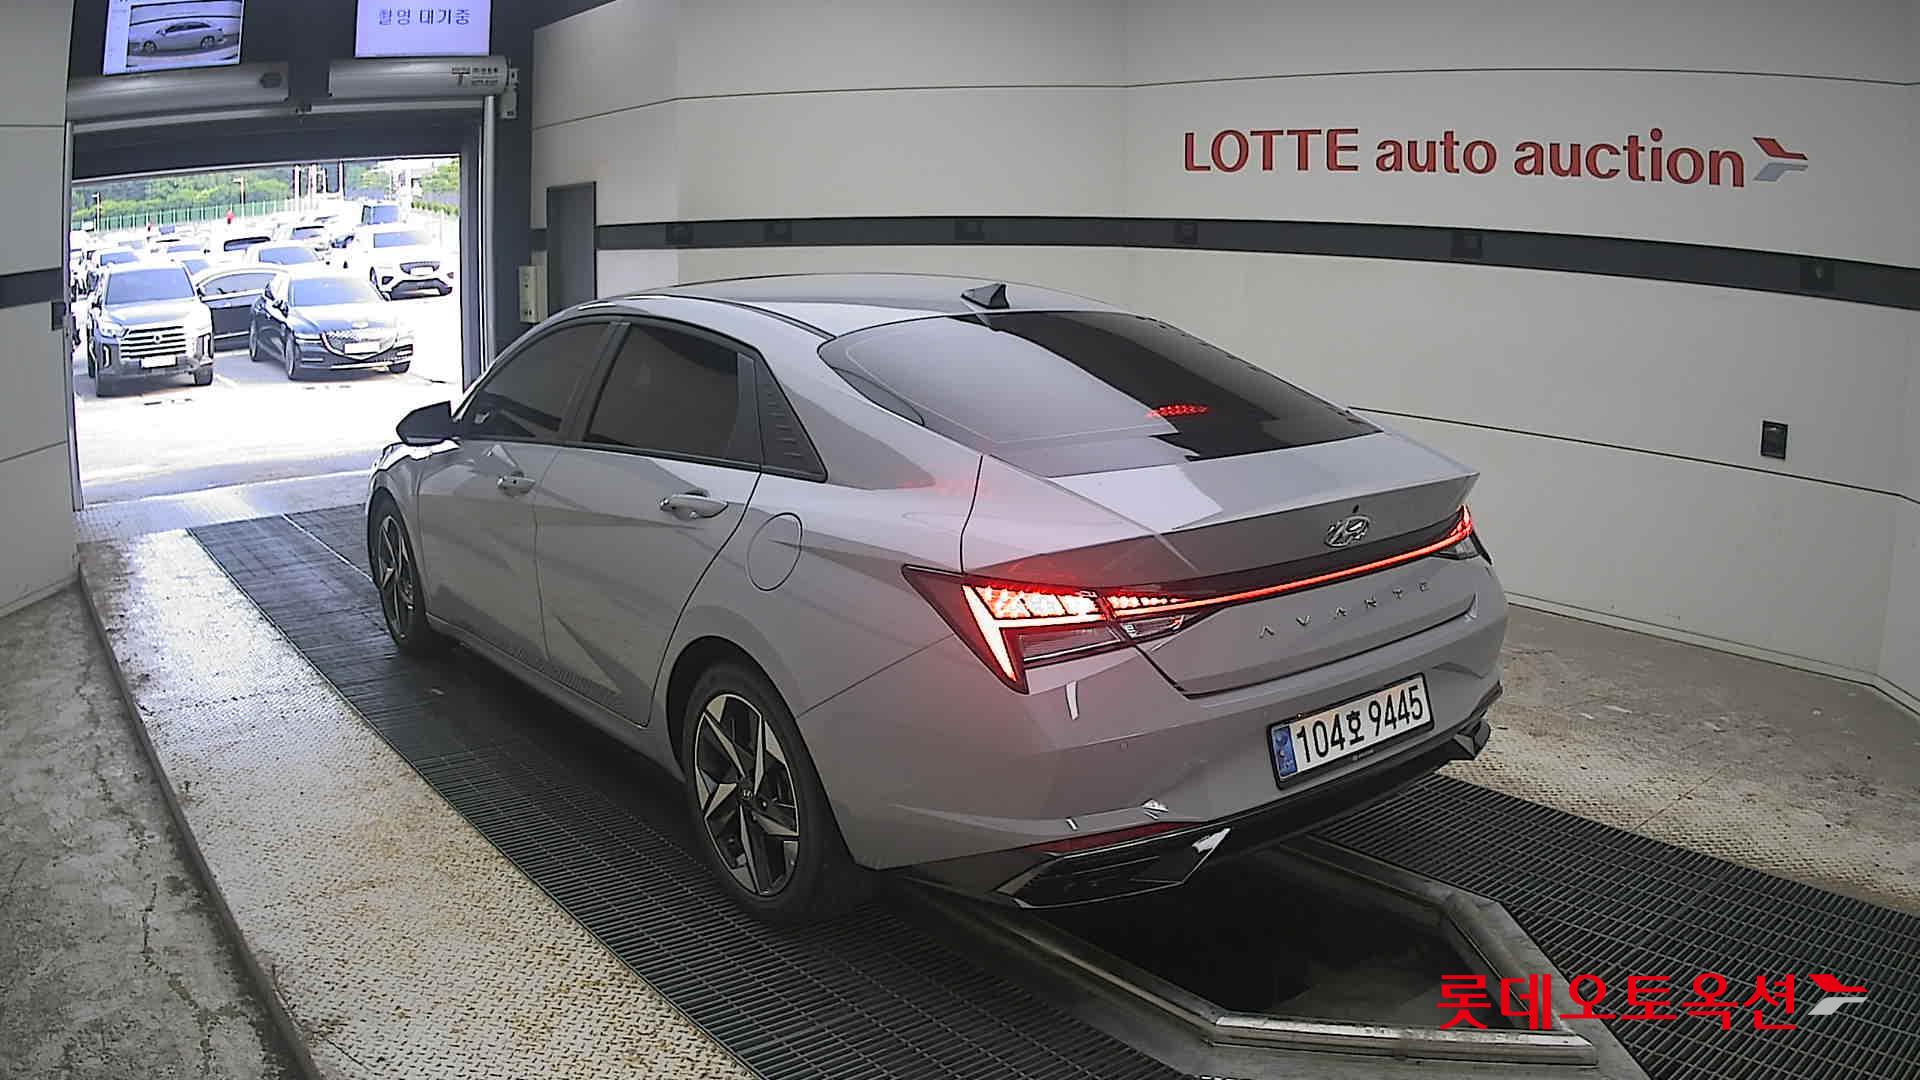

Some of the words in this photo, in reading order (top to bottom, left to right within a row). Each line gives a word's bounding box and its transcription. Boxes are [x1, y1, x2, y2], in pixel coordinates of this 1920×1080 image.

[419, 8, 470, 25] 대기중
[1184, 128, 1359, 173] LOTTE
[1376, 130, 1498, 174] auto
[1514, 128, 1745, 187] auction
[1259, 581, 1430, 639] AVANTE
[1368, 686, 1423, 737] 9445
